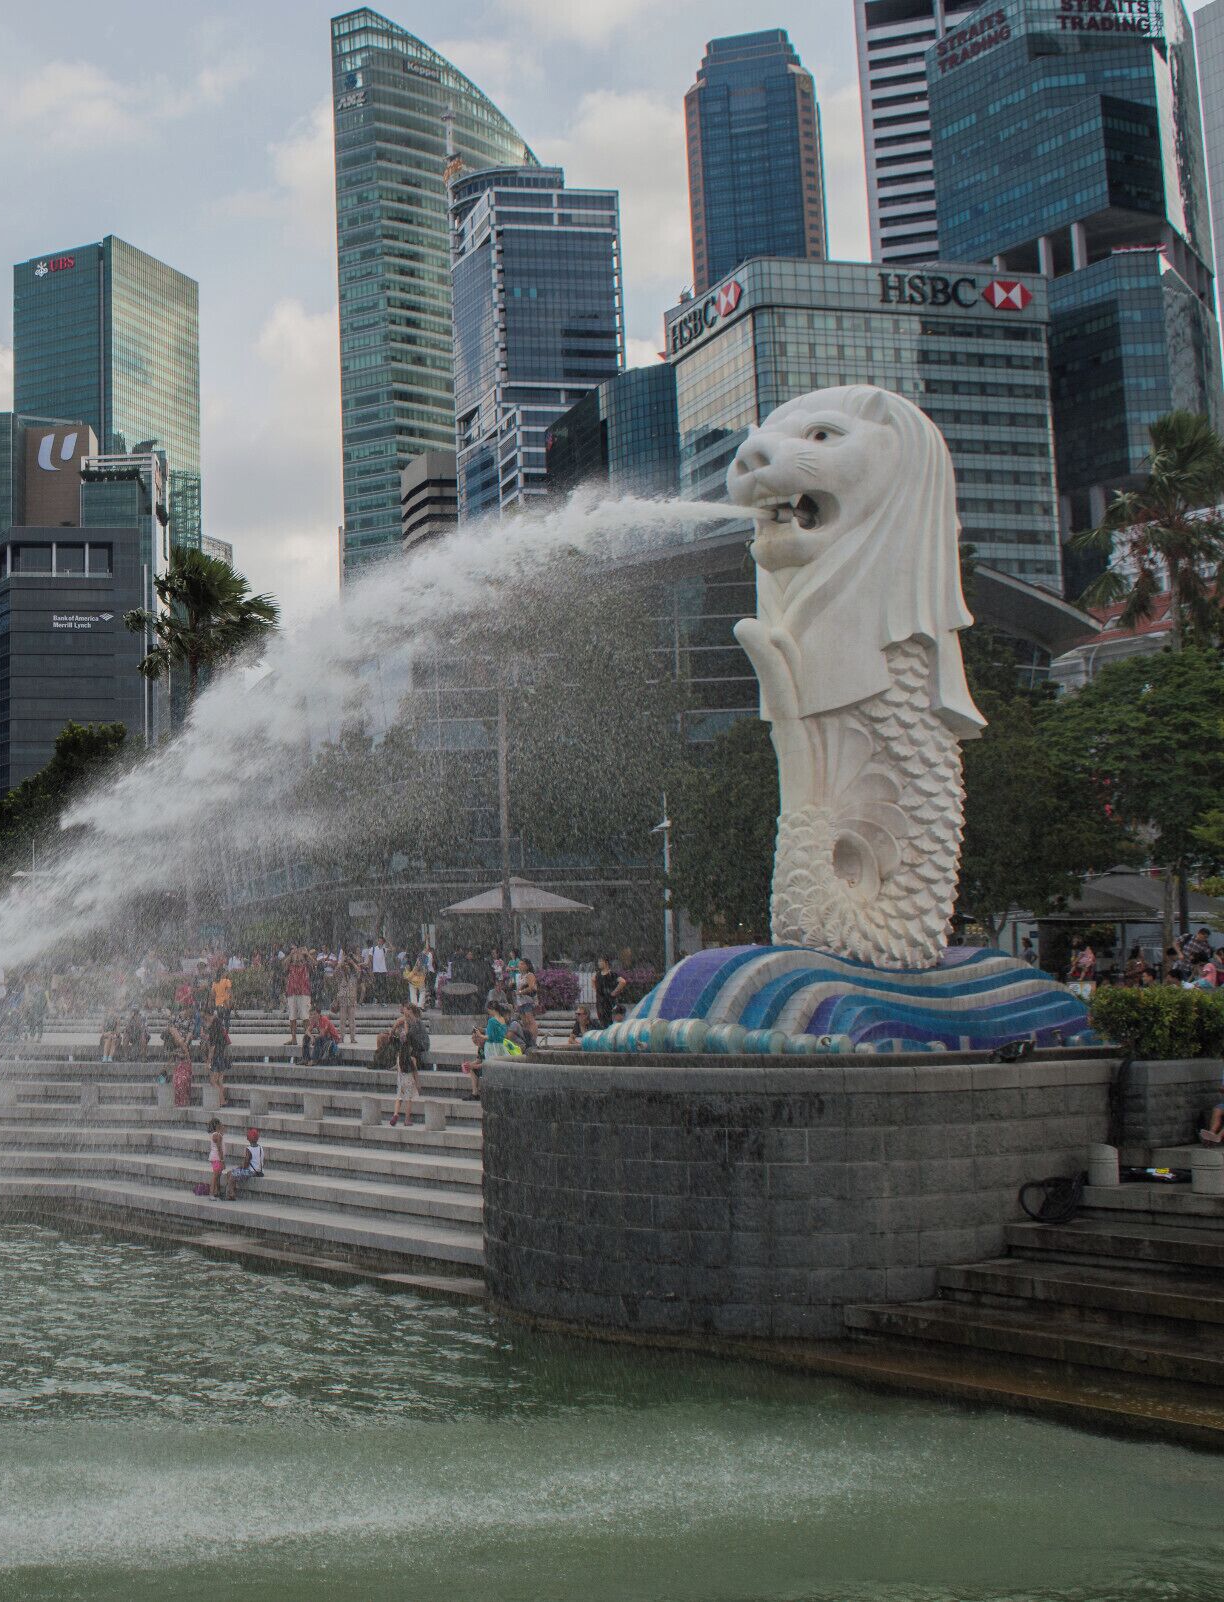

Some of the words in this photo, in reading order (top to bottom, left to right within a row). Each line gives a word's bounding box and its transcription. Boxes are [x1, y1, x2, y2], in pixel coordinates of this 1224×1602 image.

[1060, 0, 1150, 12] STRAITS
[937, 9, 1007, 56] STRAITS
[1056, 15, 1151, 33] TRADING
[938, 25, 1011, 74] TRADING
[407, 61, 440, 79] Keppel
[336, 91, 368, 111] ANZ
[49, 256, 75, 272] UBS
[878, 272, 978, 308] HSBC
[671, 296, 717, 355] HSBC
